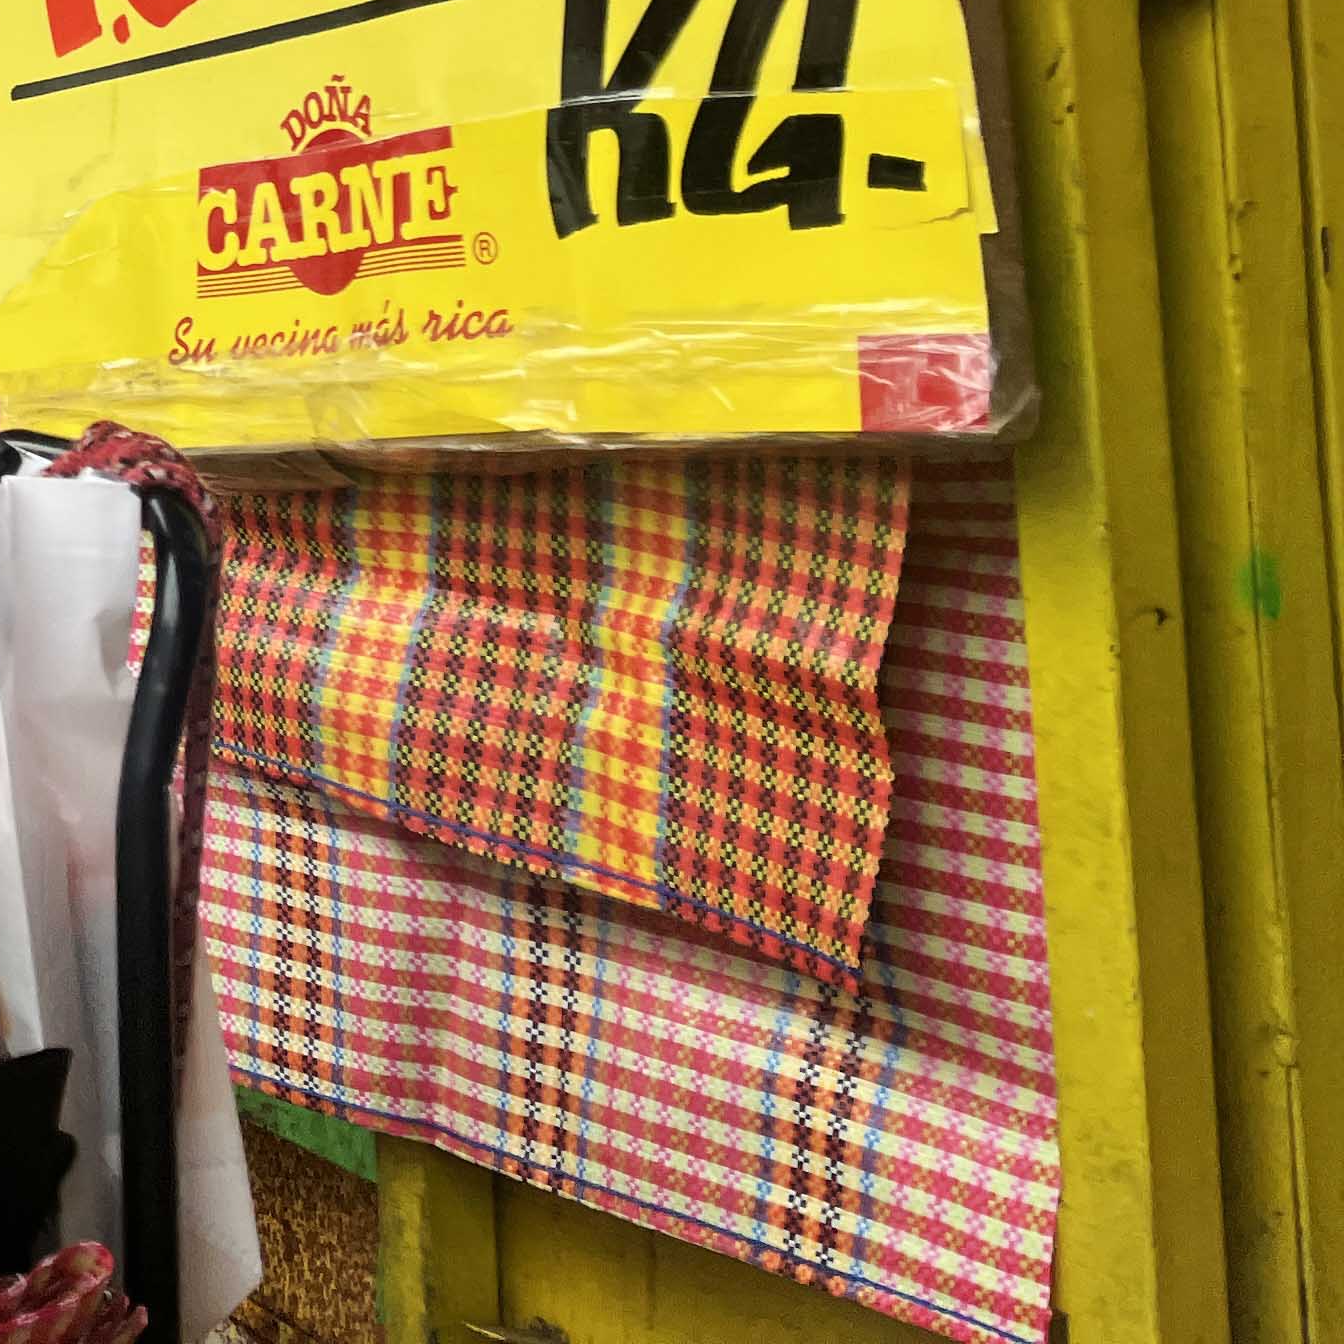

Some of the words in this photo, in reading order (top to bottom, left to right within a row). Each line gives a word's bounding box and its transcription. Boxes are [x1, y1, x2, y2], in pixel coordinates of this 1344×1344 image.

[279, 73, 373, 152] DOÑA
[197, 148, 458, 272] CARNE
[167, 315, 219, 367] Su
[231, 318, 341, 360] vecina
[421, 298, 517, 344] rica
